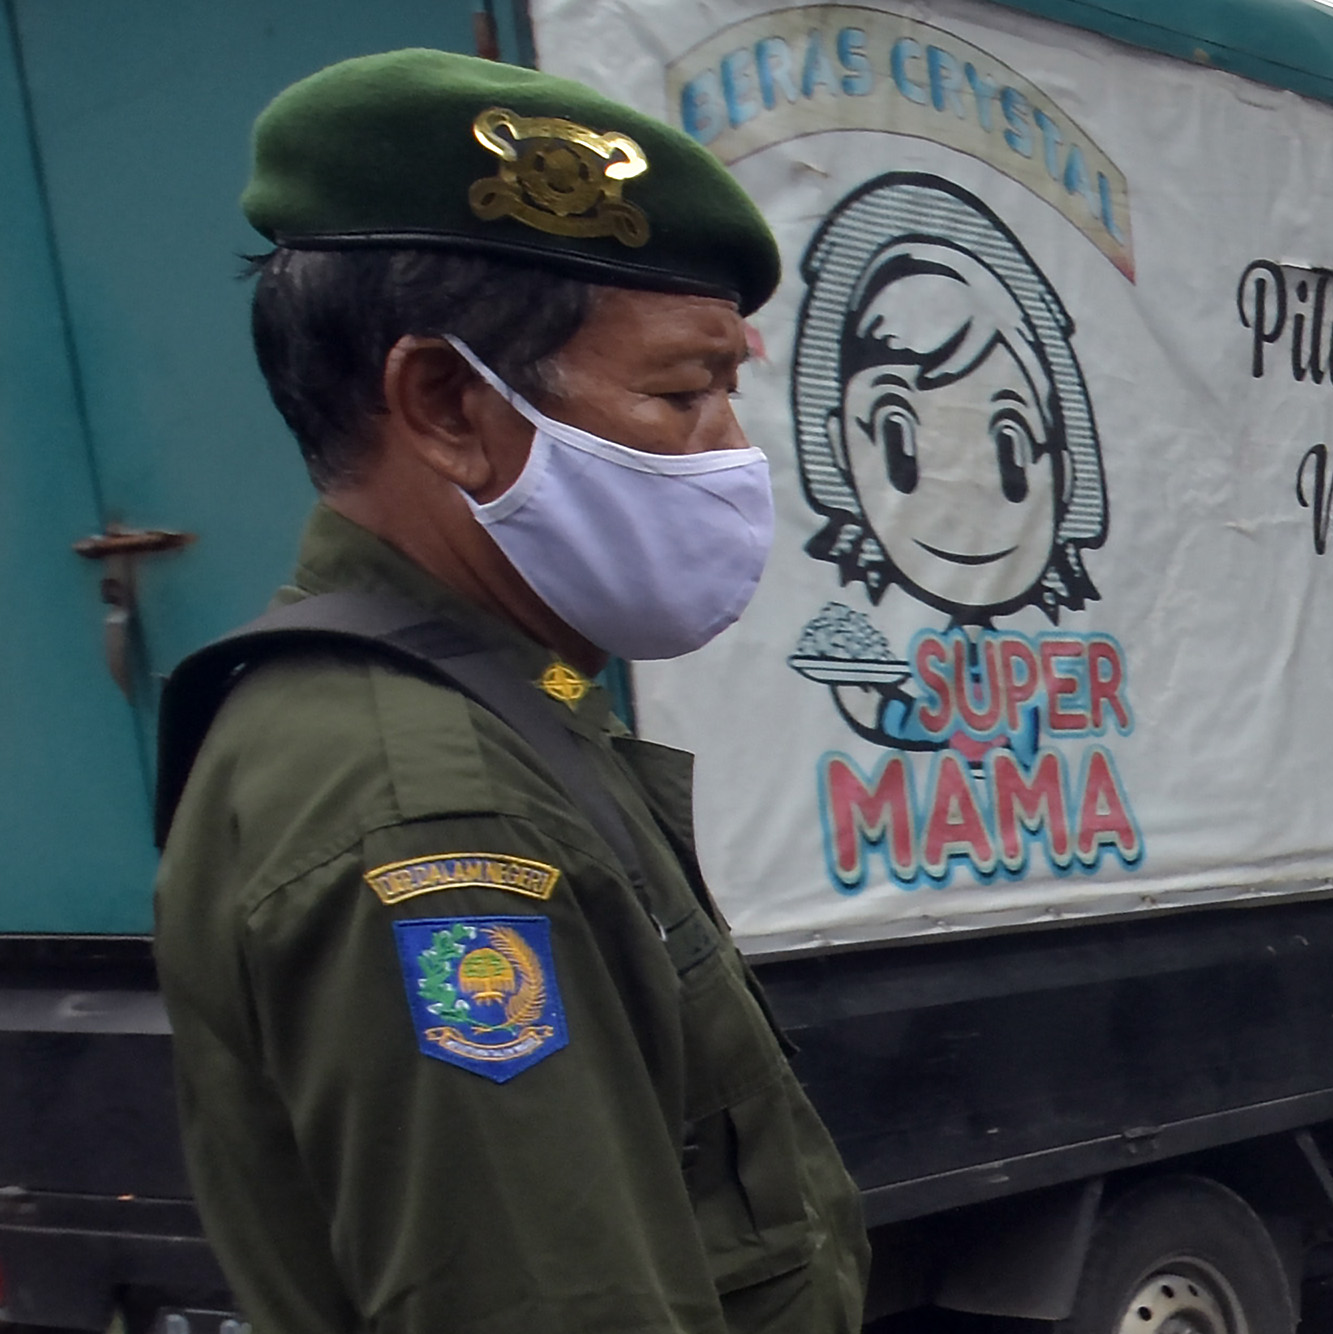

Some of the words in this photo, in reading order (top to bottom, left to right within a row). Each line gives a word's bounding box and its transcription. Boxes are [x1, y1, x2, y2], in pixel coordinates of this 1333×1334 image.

[680, 26, 874, 145] BERAS
[890, 37, 1126, 246] CRYSTAL
[912, 633, 1132, 736] SUPER
[822, 748, 1140, 887] MAMA
